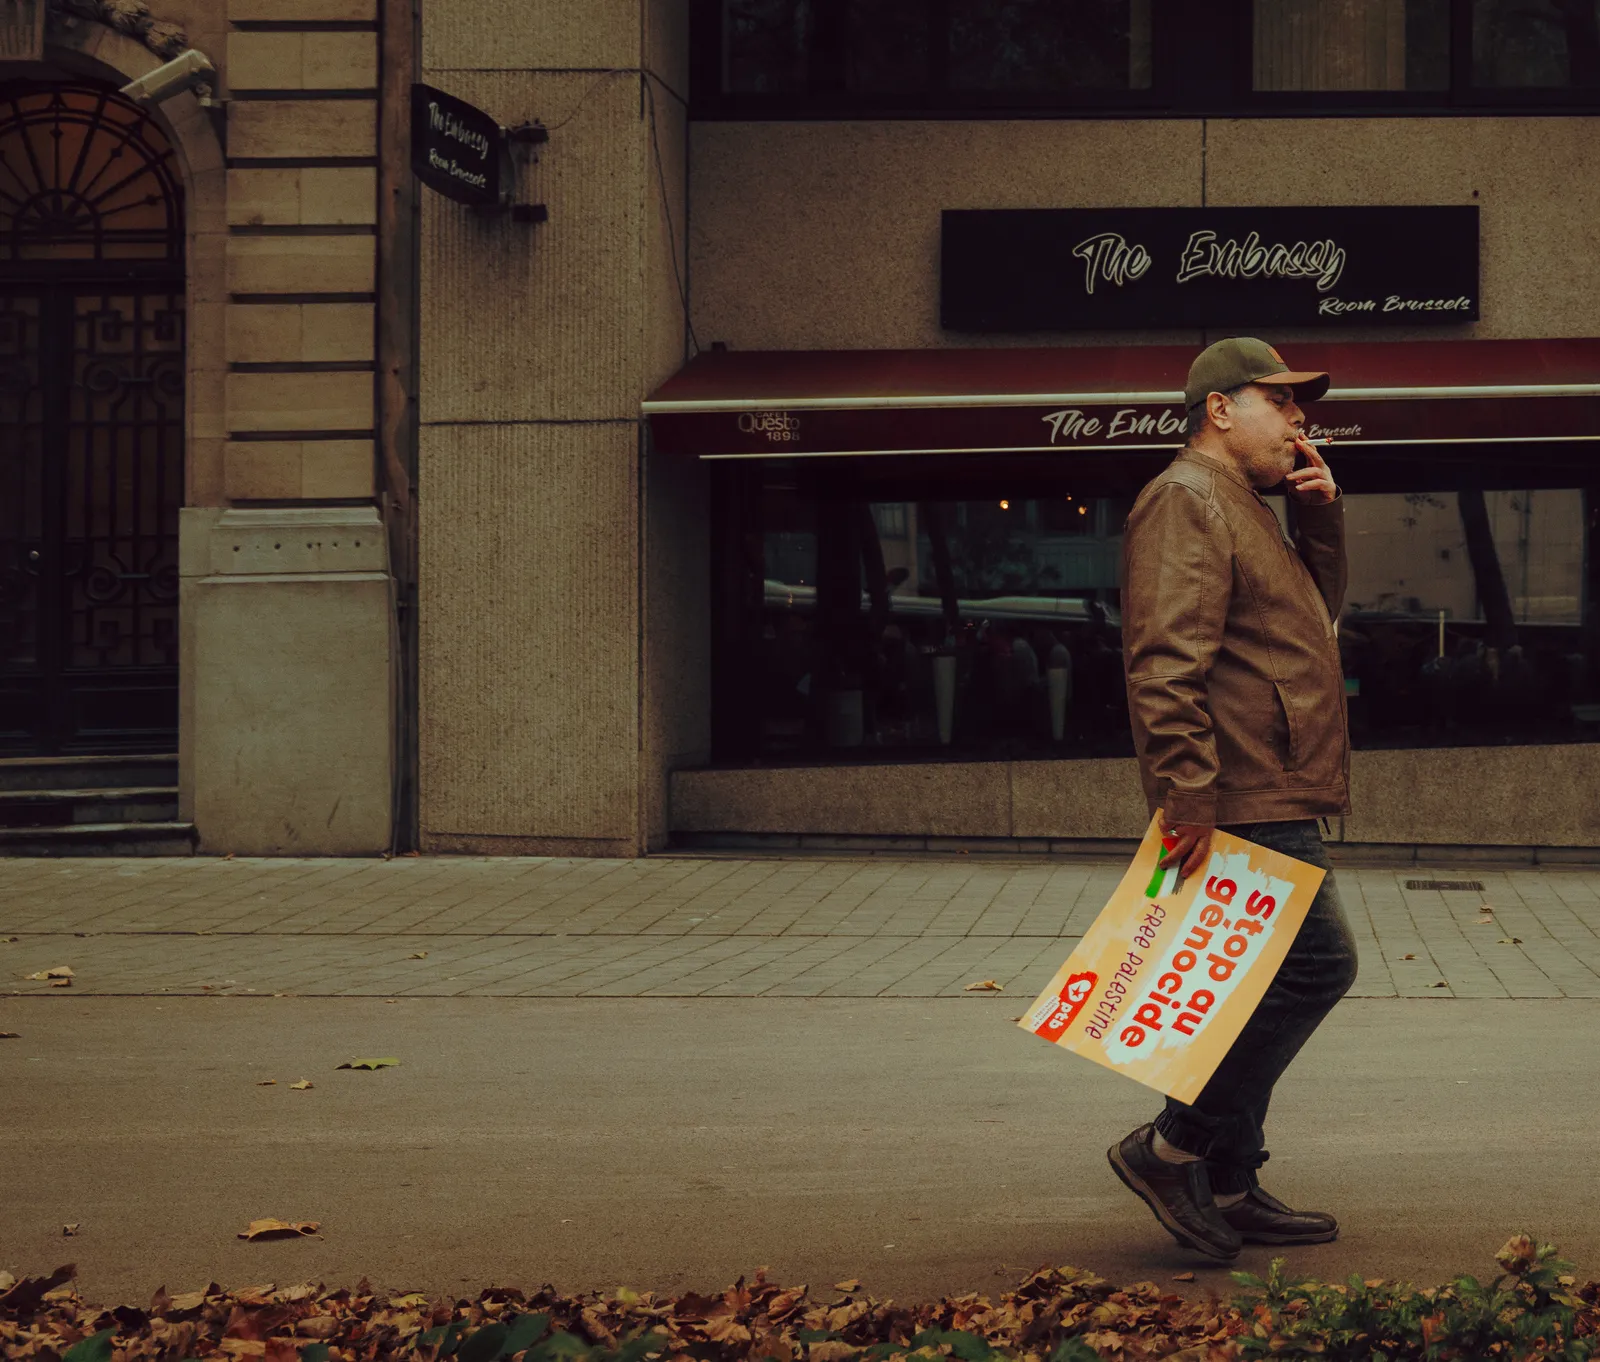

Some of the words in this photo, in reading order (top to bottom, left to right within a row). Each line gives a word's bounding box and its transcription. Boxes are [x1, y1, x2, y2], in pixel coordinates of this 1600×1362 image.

[428, 101, 444, 132] The
[444, 112, 489, 160] Embassy
[428, 147, 449, 170] Room
[450, 160, 486, 189] Brussels
[1072, 232, 1152, 295] The
[1176, 230, 1346, 291] Embassy
[1318, 296, 1376, 316] Room
[1382, 295, 1471, 313] Brussels
[738, 412, 801, 434] Questo
[766, 431, 801, 442] 1898
[1041, 409, 1103, 444] The
[1308, 423, 1362, 438] Brussels
[1206, 889, 1276, 983] Stop
[1120, 875, 1237, 1048] génocide
[1048, 1001, 1074, 1029] ptb
[1171, 988, 1215, 1036] au
